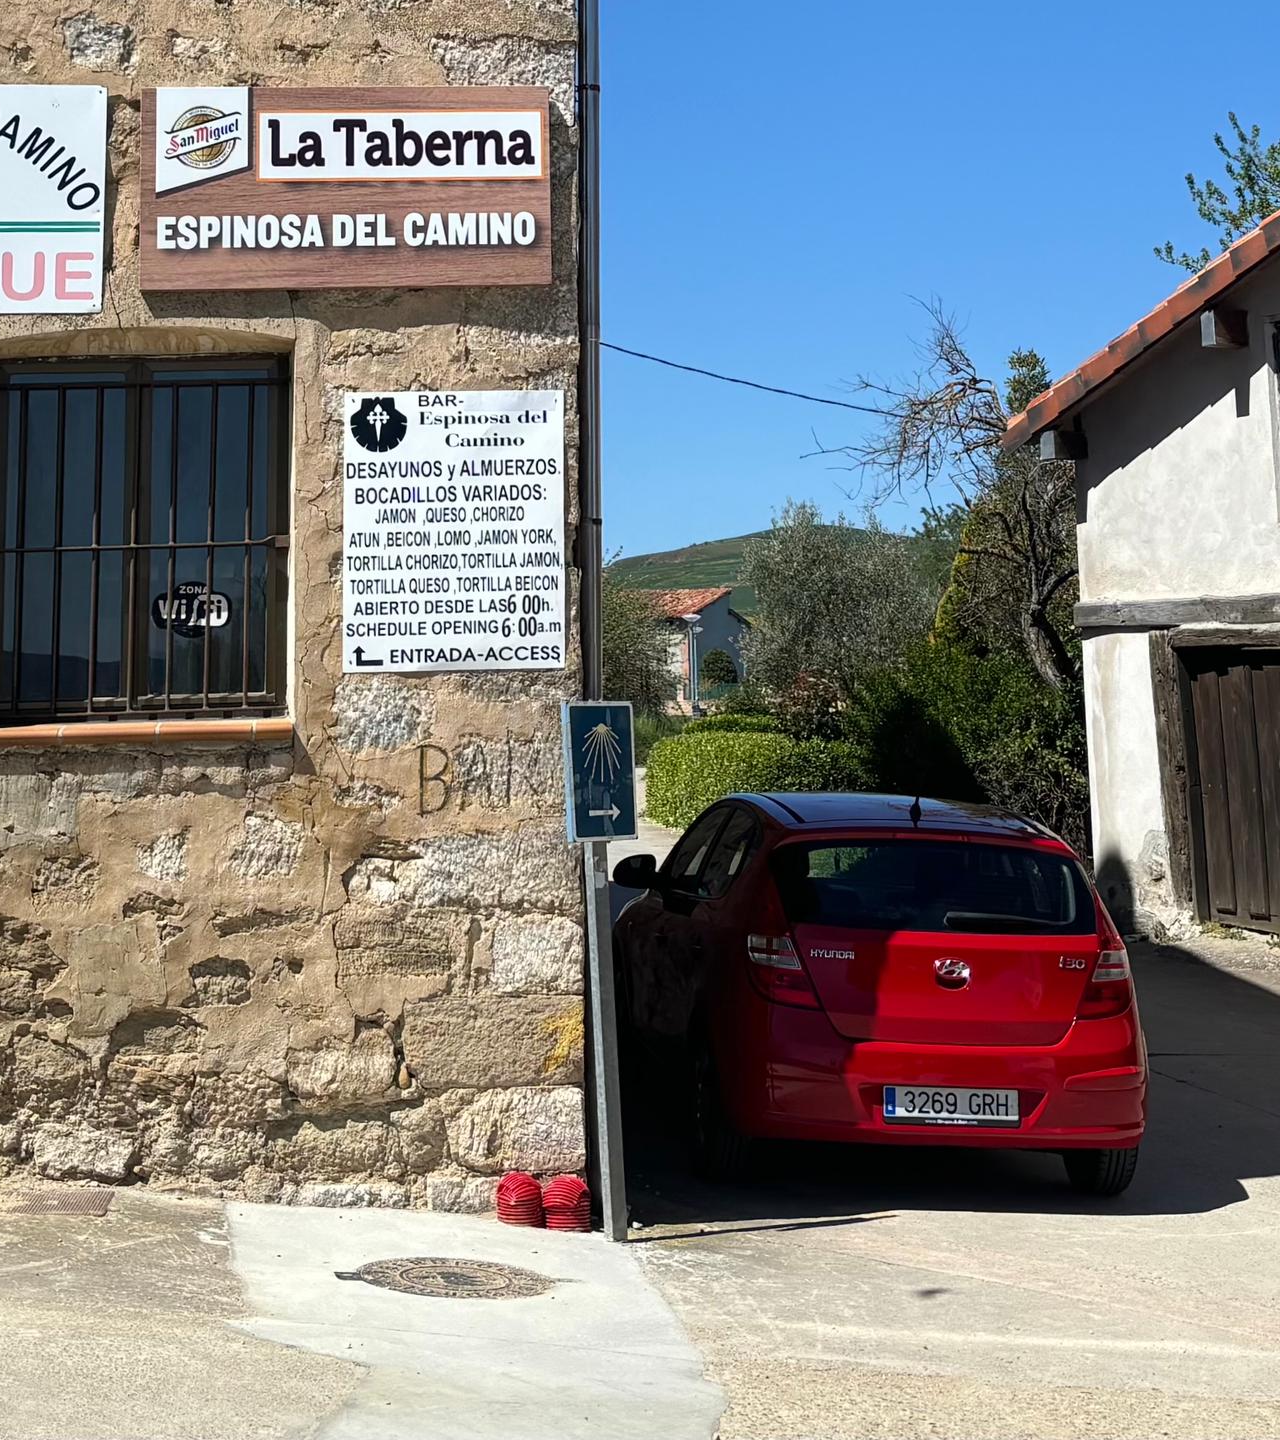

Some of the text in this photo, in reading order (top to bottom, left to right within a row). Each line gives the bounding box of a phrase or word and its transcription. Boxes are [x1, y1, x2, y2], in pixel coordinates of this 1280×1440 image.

[268, 119, 325, 167] La
[333, 118, 535, 166] Taberna
[156, 211, 536, 250] ESPINOSA DEL CAMINO
[419, 410, 548, 428] Espinosa del
[445, 432, 525, 448] Camino
[346, 458, 561, 481] DESAYUNOS y ALMUERZOS.
[355, 484, 547, 505] BOCADILLOS VARIADOS:
[375, 508, 416, 524] JAMON
[349, 532, 379, 548] ATUN
[521, 528, 557, 546] YORK,
[347, 555, 403, 571] TORTILLA
[520, 552, 563, 569] JAMON,
[179, 585, 208, 594] ZONA
[350, 579, 405, 595] TORTILLA
[409, 578, 450, 594] QUESO
[515, 575, 558, 591] BEICON
[354, 601, 419, 616] ABIERTO
[424, 600, 474, 614] DESDE
[346, 622, 427, 637] SCHEDULE
[431, 620, 499, 636] OPENING
[810, 948, 855, 960] HYUNDAI
[904, 1091, 1009, 1116] 3269 GRH
